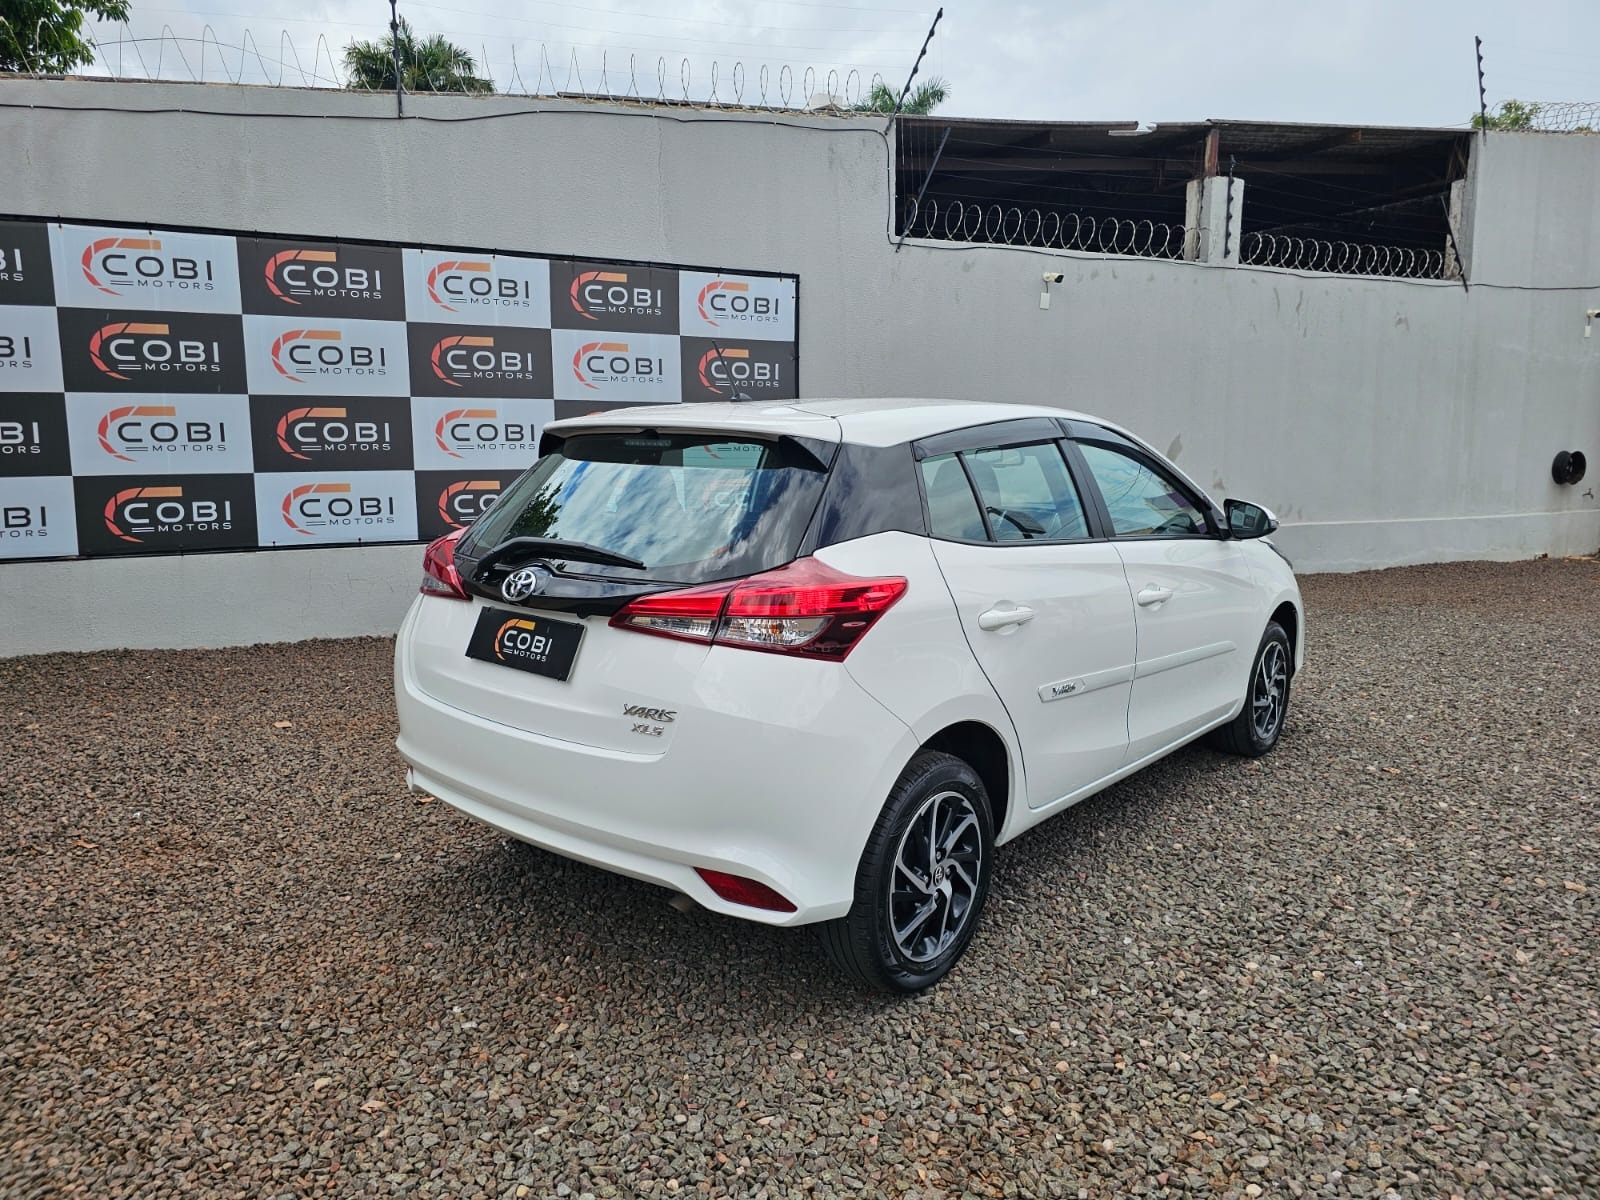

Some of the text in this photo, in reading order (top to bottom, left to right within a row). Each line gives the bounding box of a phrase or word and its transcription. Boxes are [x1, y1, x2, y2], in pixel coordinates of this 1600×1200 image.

[102, 254, 213, 281] COBI
[138, 279, 214, 290] MOTORS
[282, 265, 382, 291] COBI
[443, 275, 530, 299] COBI
[314, 289, 382, 299] MOTORS
[470, 298, 530, 307] MOTORS
[585, 285, 661, 308] COBI
[608, 306, 662, 316] MOTORS
[710, 294, 779, 315] COBI
[731, 314, 779, 323] MOTORS
[109, 339, 220, 363] COBI
[289, 345, 386, 367] COBI
[145, 363, 221, 372] MOTORS
[446, 350, 533, 372] COBI
[587, 355, 663, 376] COBI
[711, 361, 779, 380] COBI
[320, 367, 386, 375] MOTORS
[473, 371, 533, 380] MOTORS
[610, 376, 664, 384] MOTORS
[117, 422, 226, 443] COBI
[294, 422, 390, 443] COBI
[451, 423, 536, 442] COBI
[152, 444, 227, 452] MOTORS
[325, 443, 391, 451] MOTORS
[124, 500, 232, 524] COBI
[300, 496, 394, 518] COBI
[158, 522, 232, 532] MOTORS
[329, 516, 395, 526] MOTORS
[504, 630, 553, 655] COBI
[513, 649, 547, 662] MOTORS
